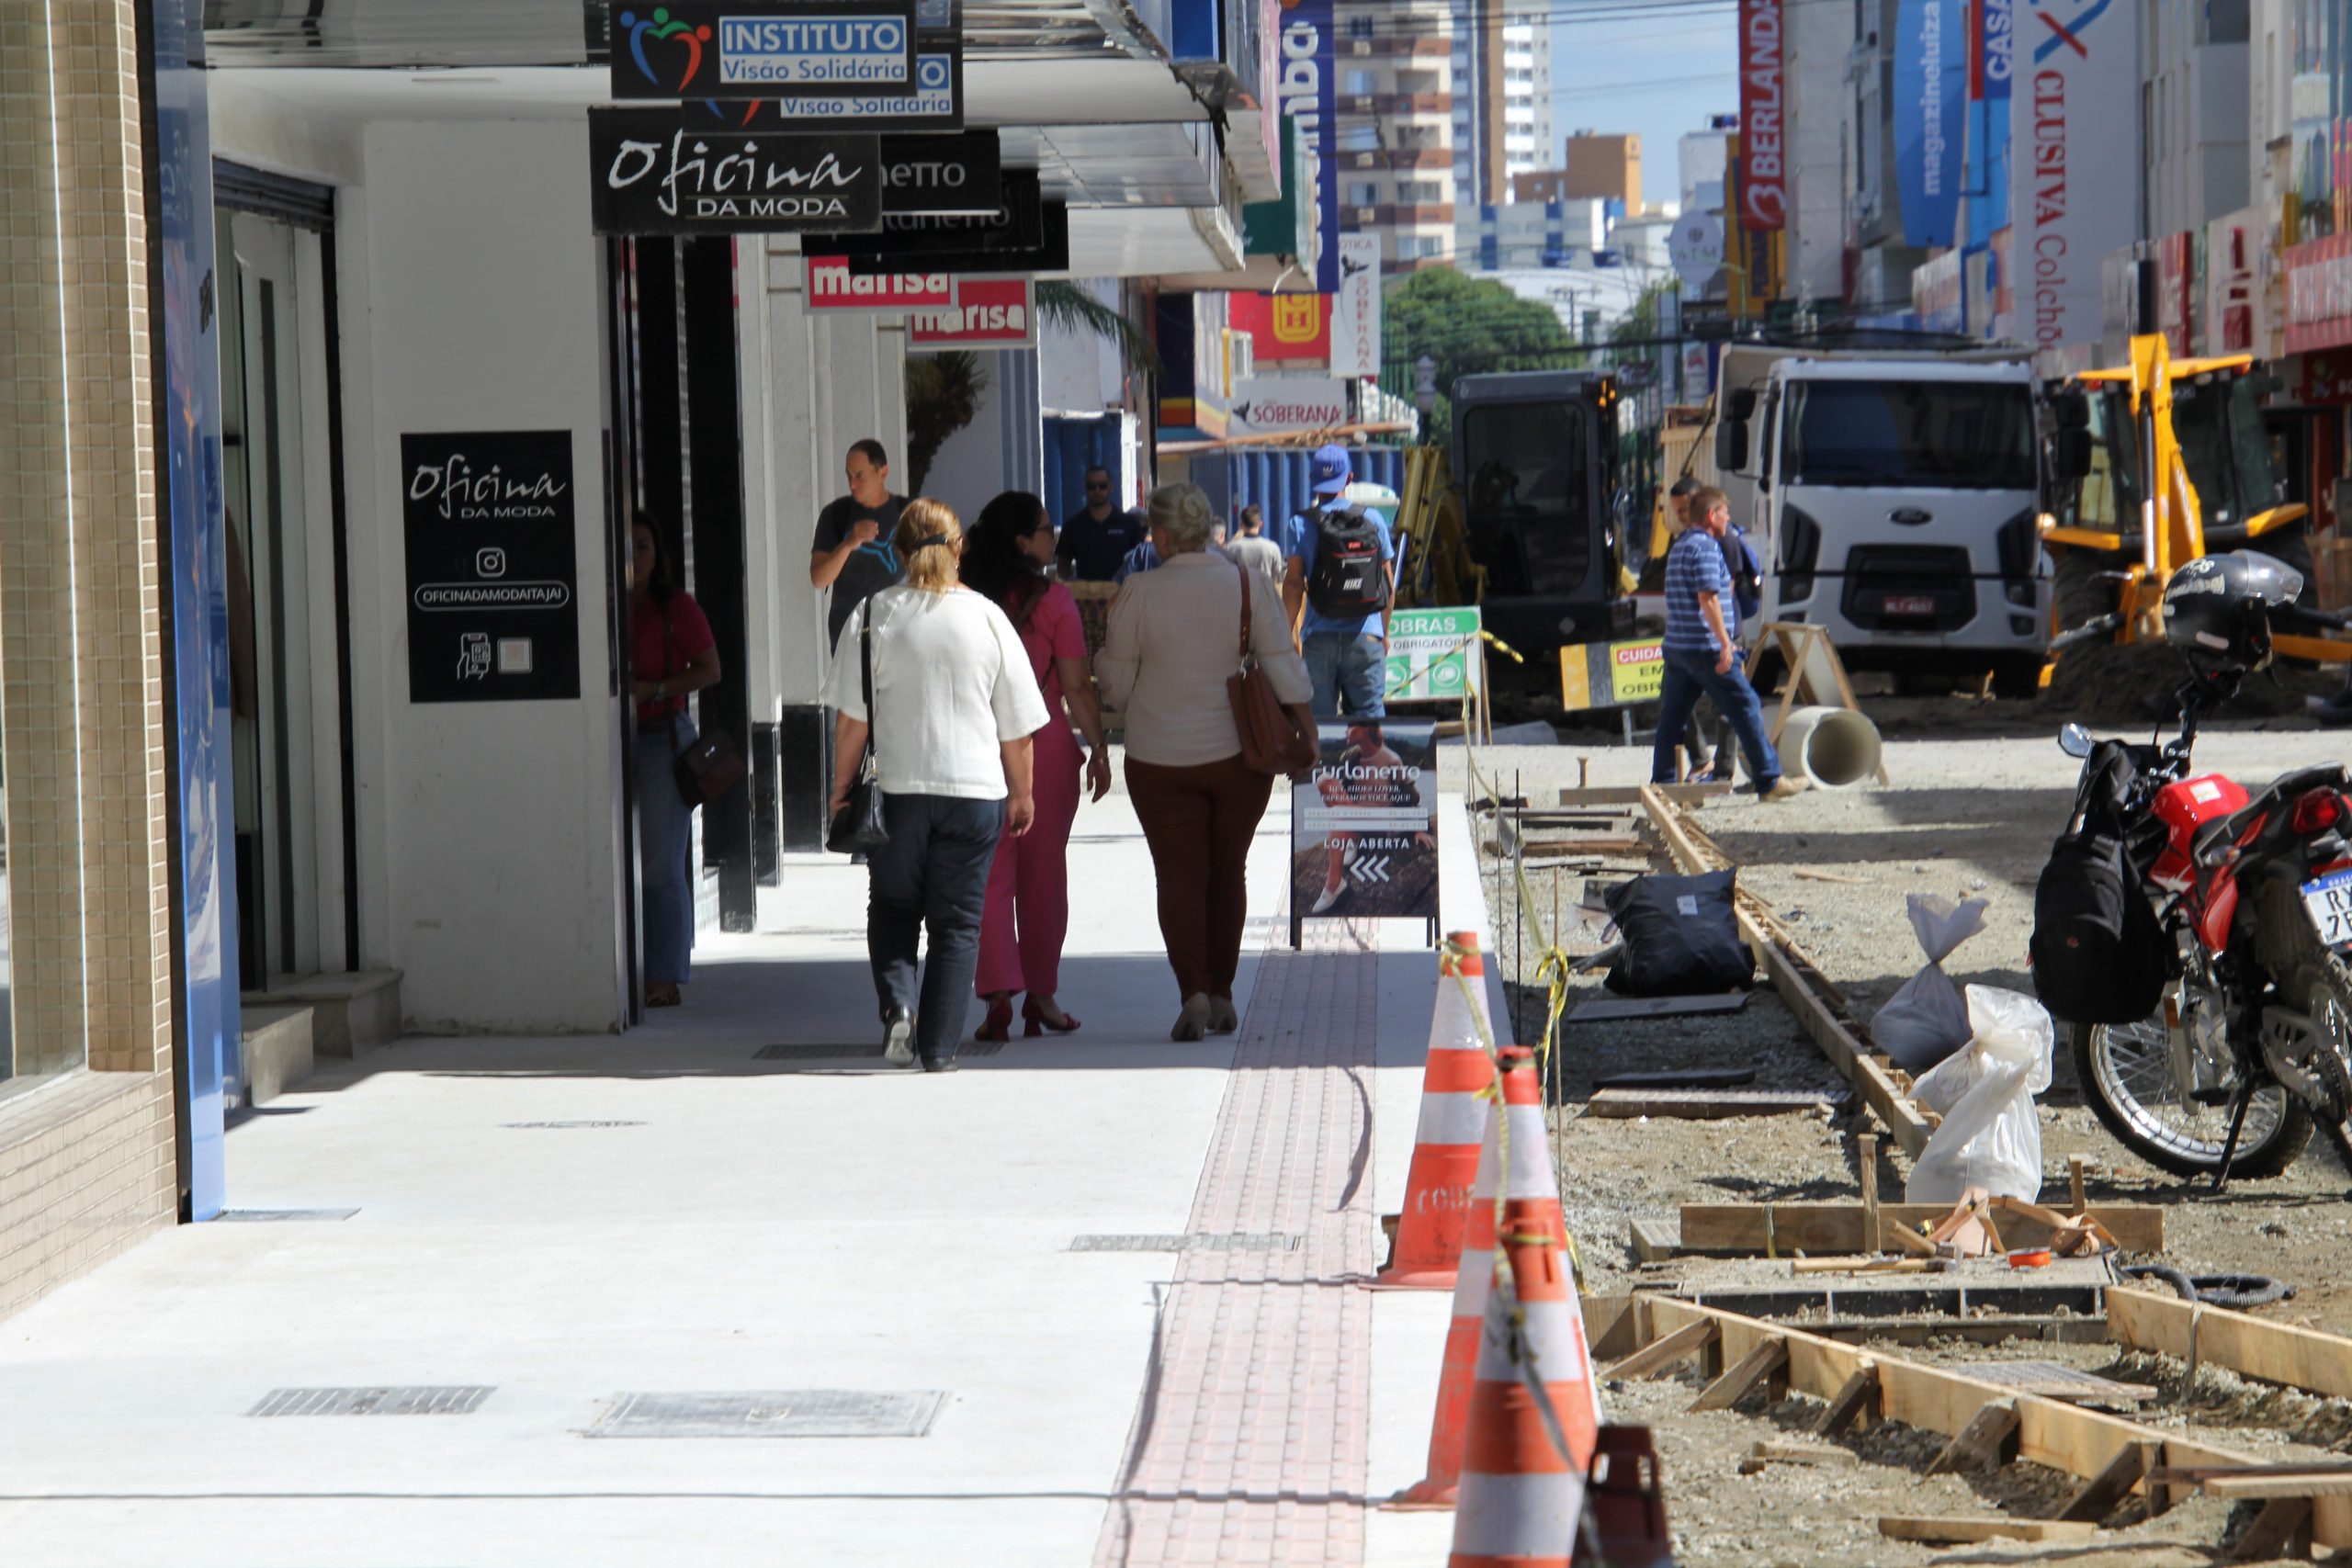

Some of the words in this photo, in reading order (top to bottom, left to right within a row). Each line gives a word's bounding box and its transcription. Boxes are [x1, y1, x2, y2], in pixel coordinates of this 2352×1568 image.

[726, 23, 900, 51] INSTITUTO
[723, 60, 789, 79] Visão
[798, 58, 905, 80] Solidária
[608, 128, 862, 216] Oficina
[696, 197, 740, 216] DA
[751, 197, 847, 216] MODA
[1253, 404, 1341, 423] SOBERANA
[410, 454, 566, 519] Oficina
[461, 506, 489, 519] DA
[494, 506, 556, 518] MODA
[1343, 578, 1363, 590] NIKE
[1324, 838, 1354, 851] LOJA
[1359, 838, 1409, 850] ABERTA
